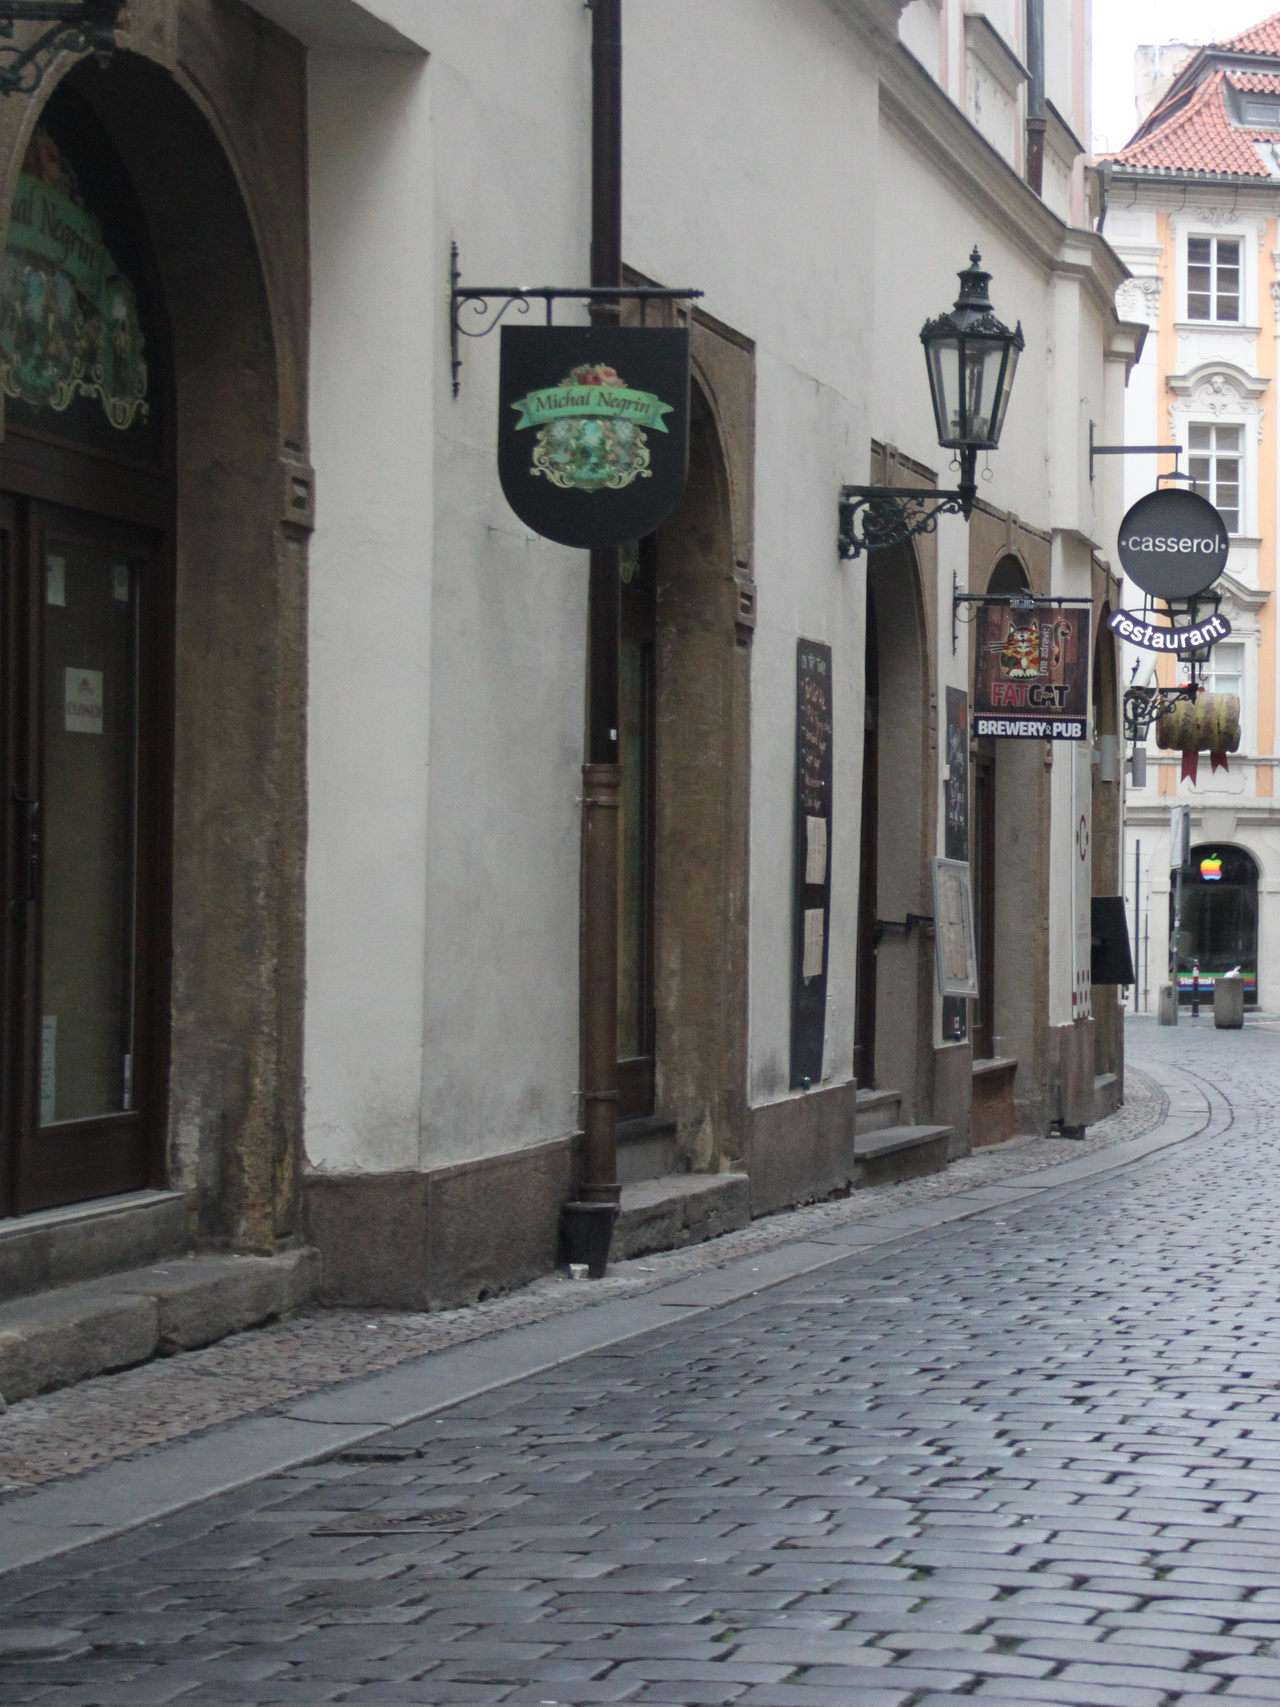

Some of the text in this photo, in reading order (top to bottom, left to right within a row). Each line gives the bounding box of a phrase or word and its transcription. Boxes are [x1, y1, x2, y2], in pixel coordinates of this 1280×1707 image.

[536, 388, 652, 416] Michal Negrin
[1128, 534, 1219, 555] casserol
[1111, 611, 1227, 649] restaurant
[978, 720, 1046, 736] BREWERY
[1052, 722, 1082, 738] PUB
